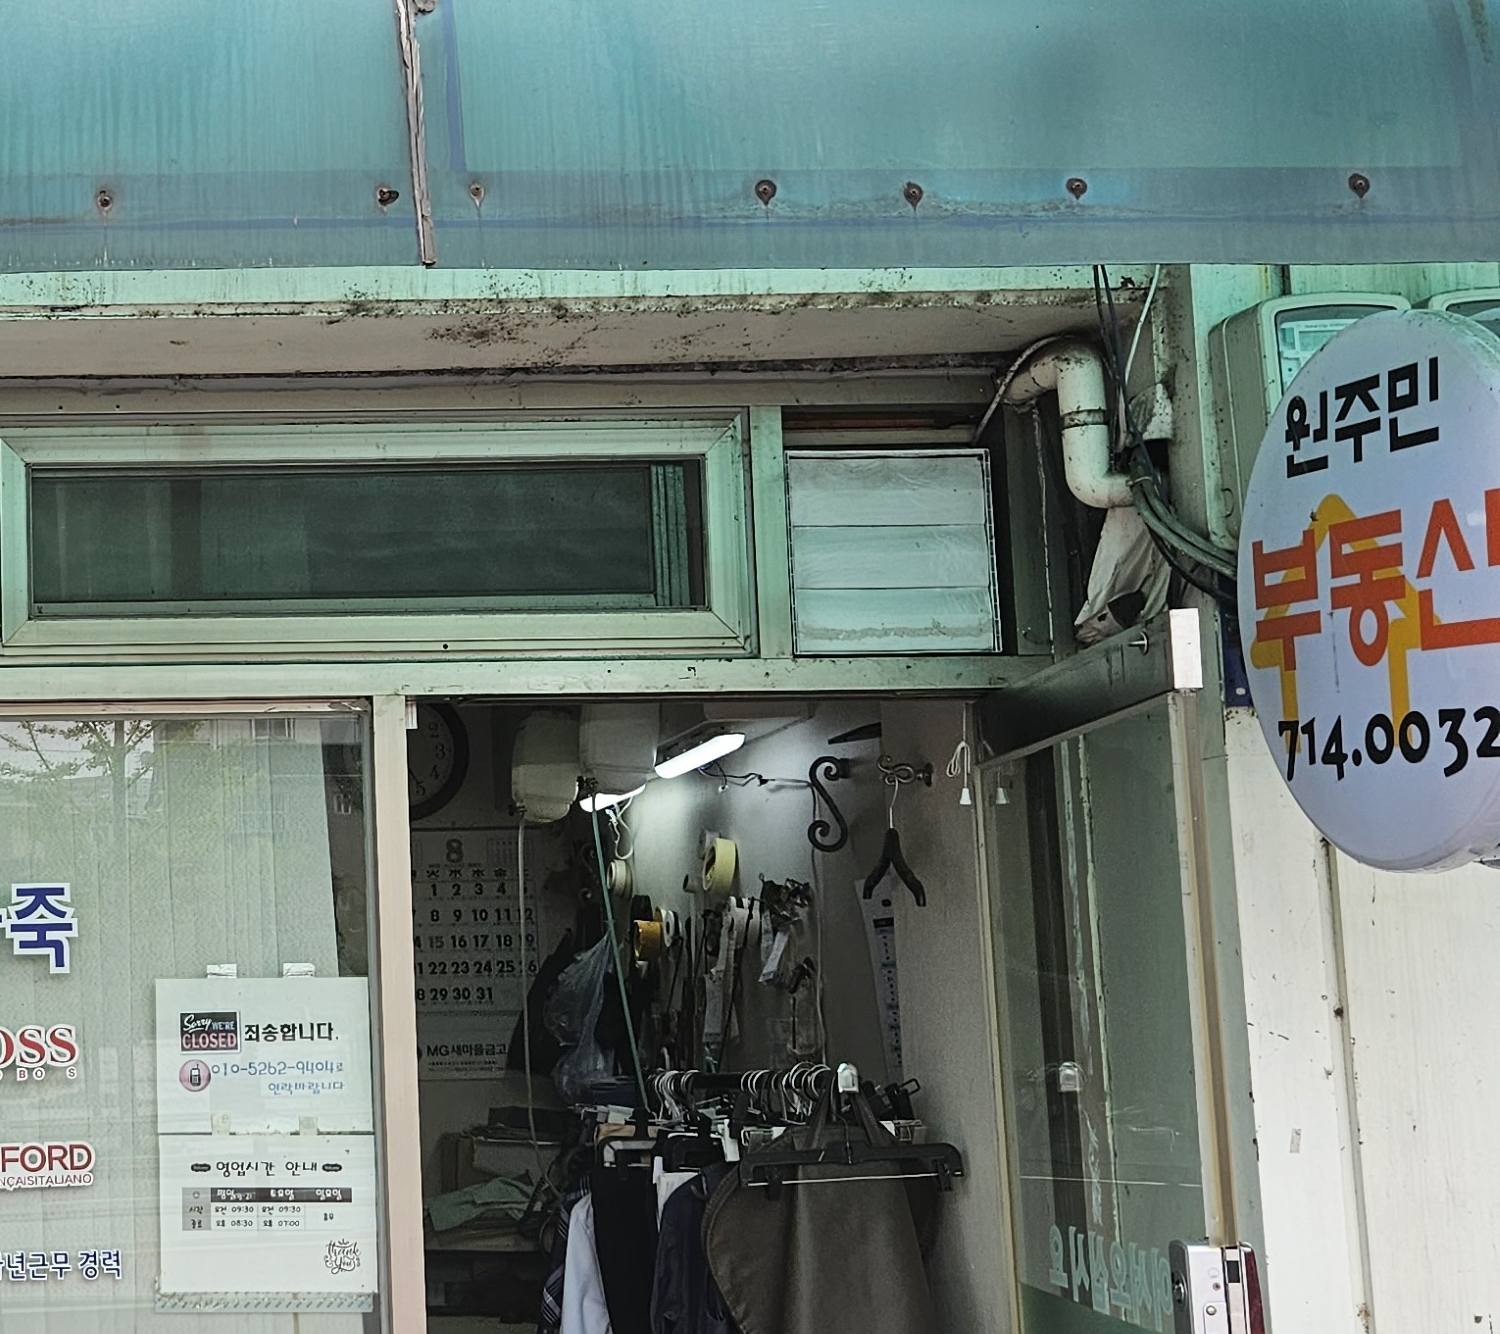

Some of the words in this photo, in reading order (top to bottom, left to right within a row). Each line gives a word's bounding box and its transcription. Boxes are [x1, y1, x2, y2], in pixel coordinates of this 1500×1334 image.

[1286, 357, 1440, 478] 원주민
[1252, 488, 1500, 671] 부동산
[1278, 706, 1500, 782] 714.0032
[445, 838, 464, 863] 8
[182, 1032, 237, 1049] CLOSED
[244, 1022, 339, 1042] 죄송합니다.
[216, 1161, 275, 1177] 영업시간
[285, 1161, 317, 1176] 안내
[78, 1249, 123, 1280] 경력
